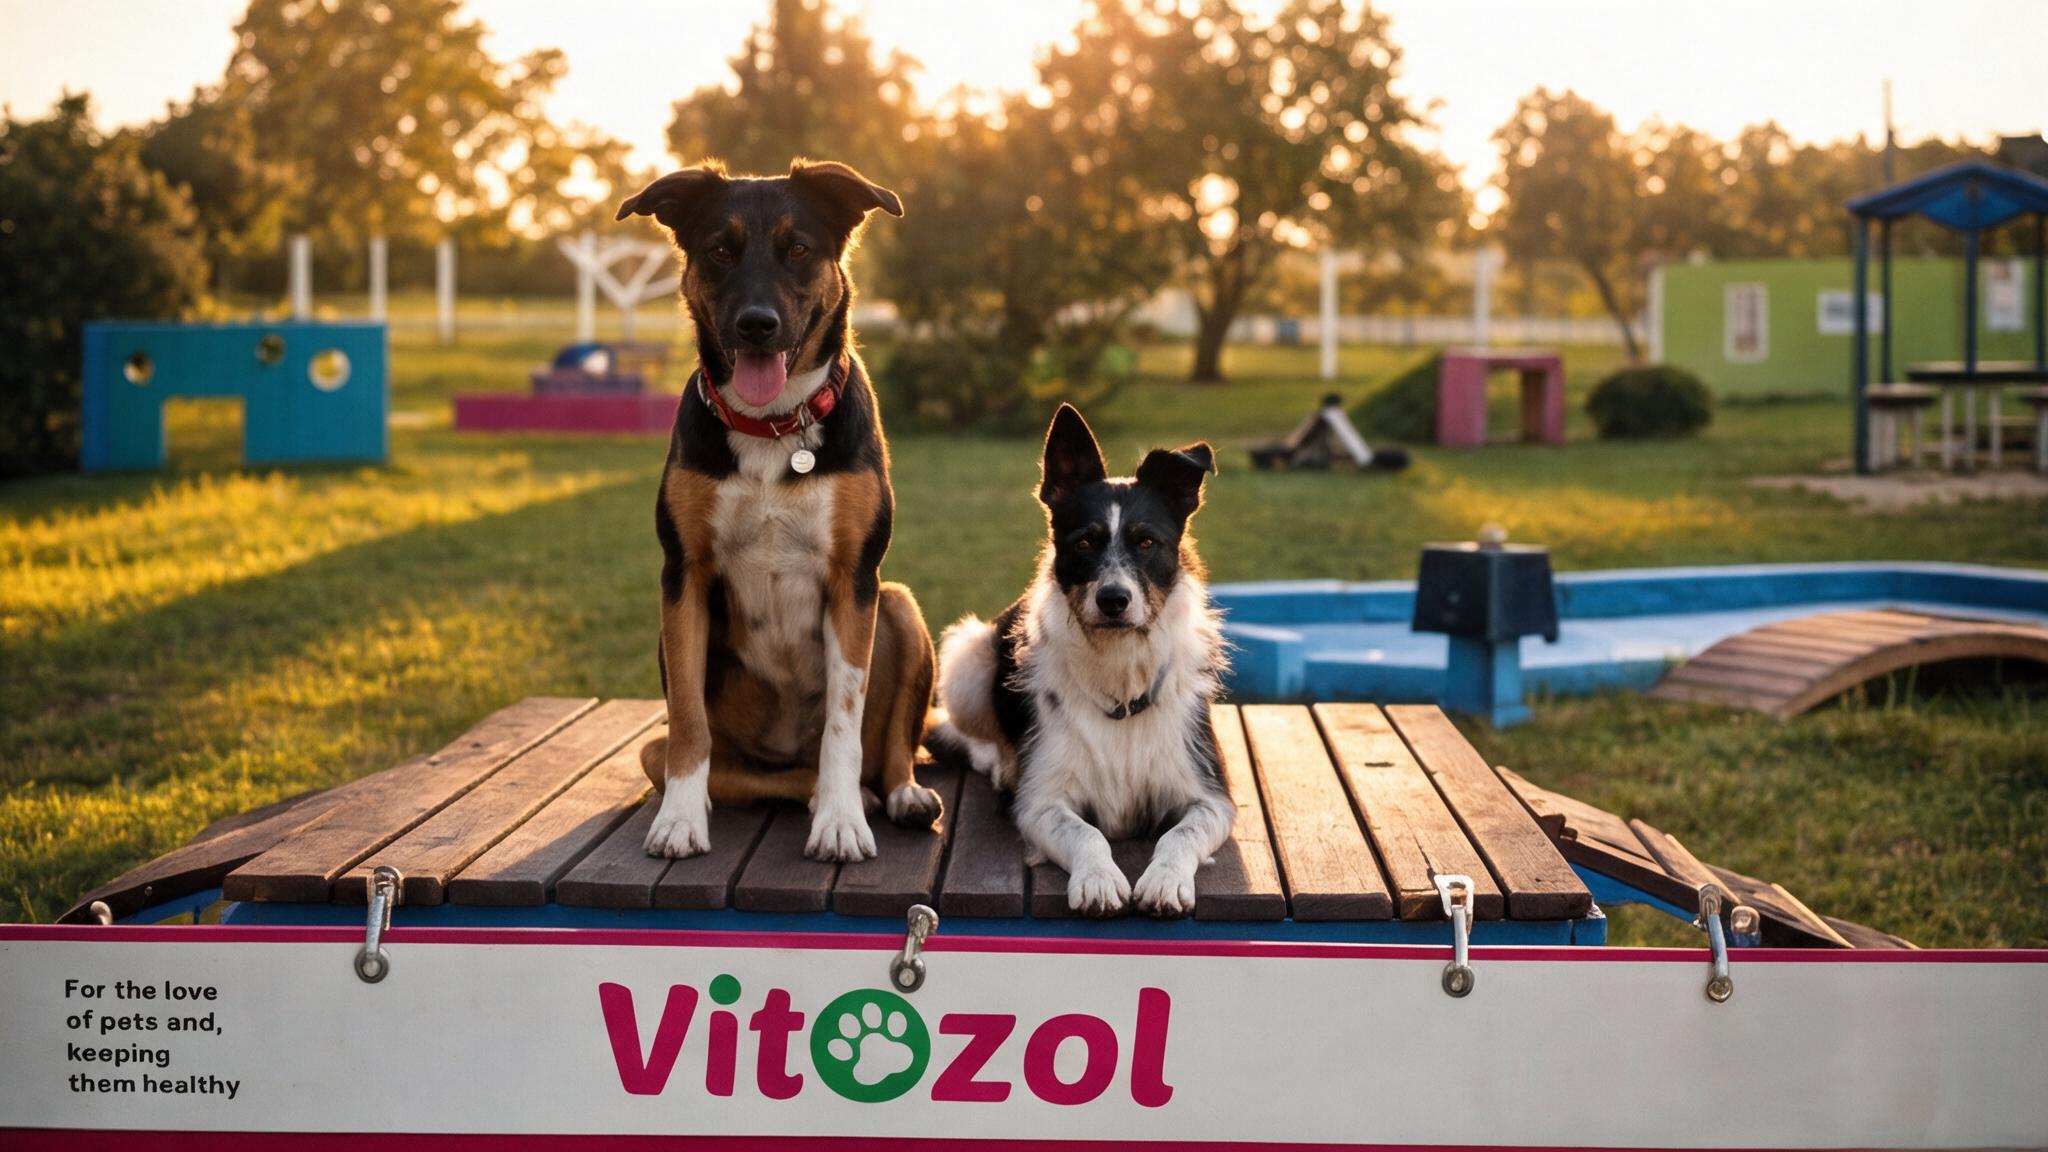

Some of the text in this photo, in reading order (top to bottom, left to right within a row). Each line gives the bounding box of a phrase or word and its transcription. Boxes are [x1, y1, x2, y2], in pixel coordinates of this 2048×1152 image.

[64, 978, 218, 1001] For the love
[65, 1008, 94, 1030] of
[100, 1012, 159, 1036] pets
[67, 1041, 170, 1069] keeping
[67, 1072, 241, 1101] them healthy
